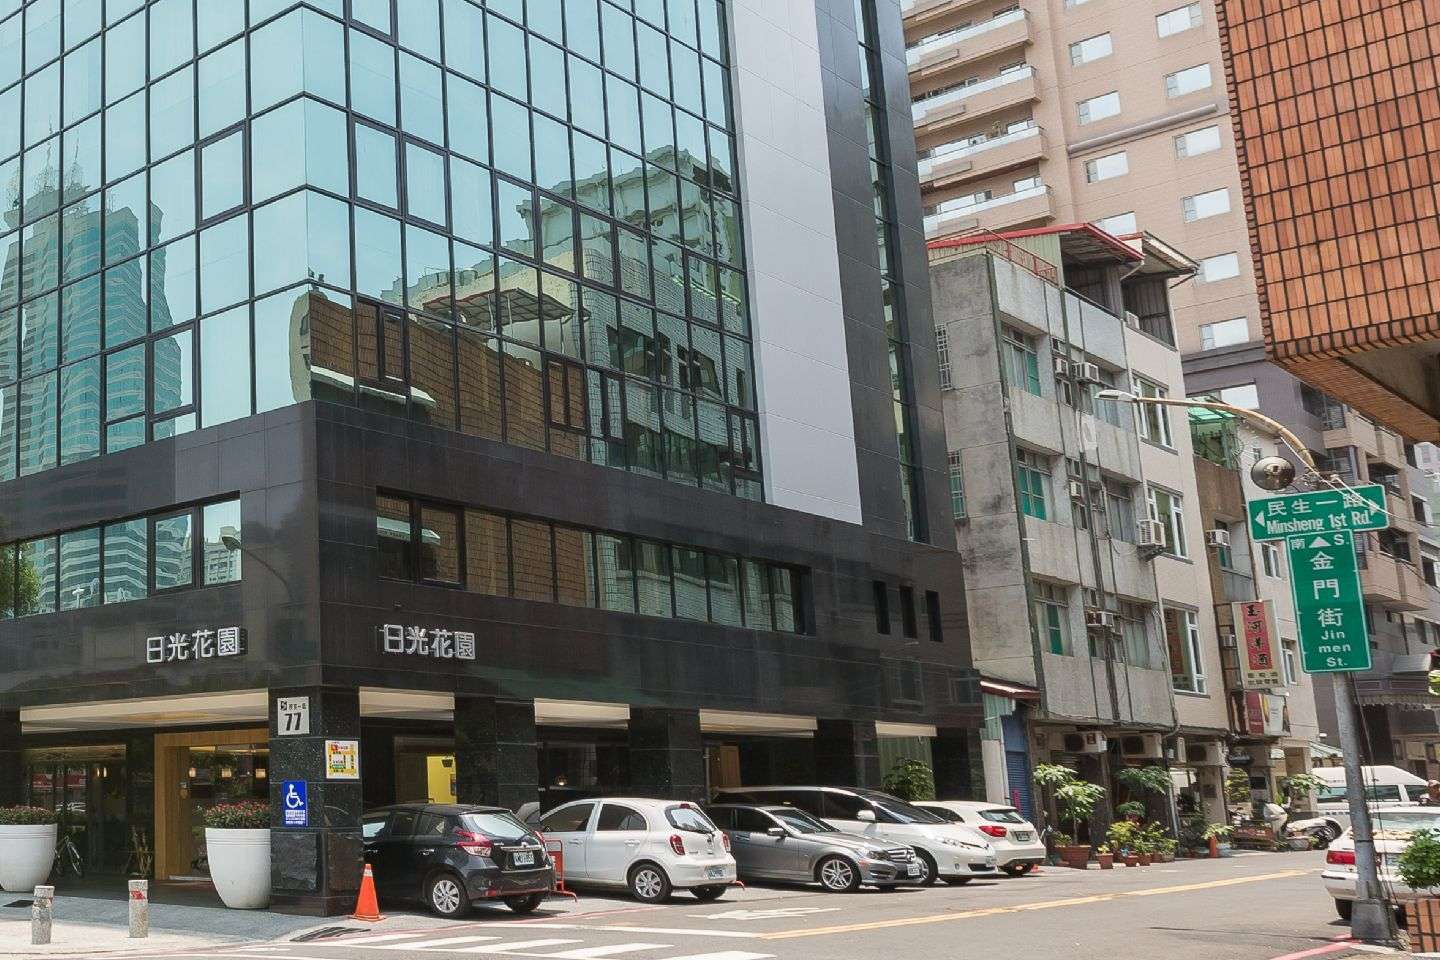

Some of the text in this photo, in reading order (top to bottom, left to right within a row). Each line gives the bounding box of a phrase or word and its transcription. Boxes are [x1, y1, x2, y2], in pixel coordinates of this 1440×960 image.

[1267, 494, 1364, 517] 民生一路
[1267, 517, 1324, 535] Minsheng
[1328, 514, 1346, 528] 1st
[1290, 538, 1305, 550] 南
[1310, 551, 1344, 628] 金門街
[146, 626, 241, 664] 日光花園
[383, 624, 476, 661] 日光花園
[1321, 630, 1345, 641] Jin
[1319, 643, 1351, 654] men
[1327, 657, 1348, 667] St.
[285, 713, 301, 731] 77
